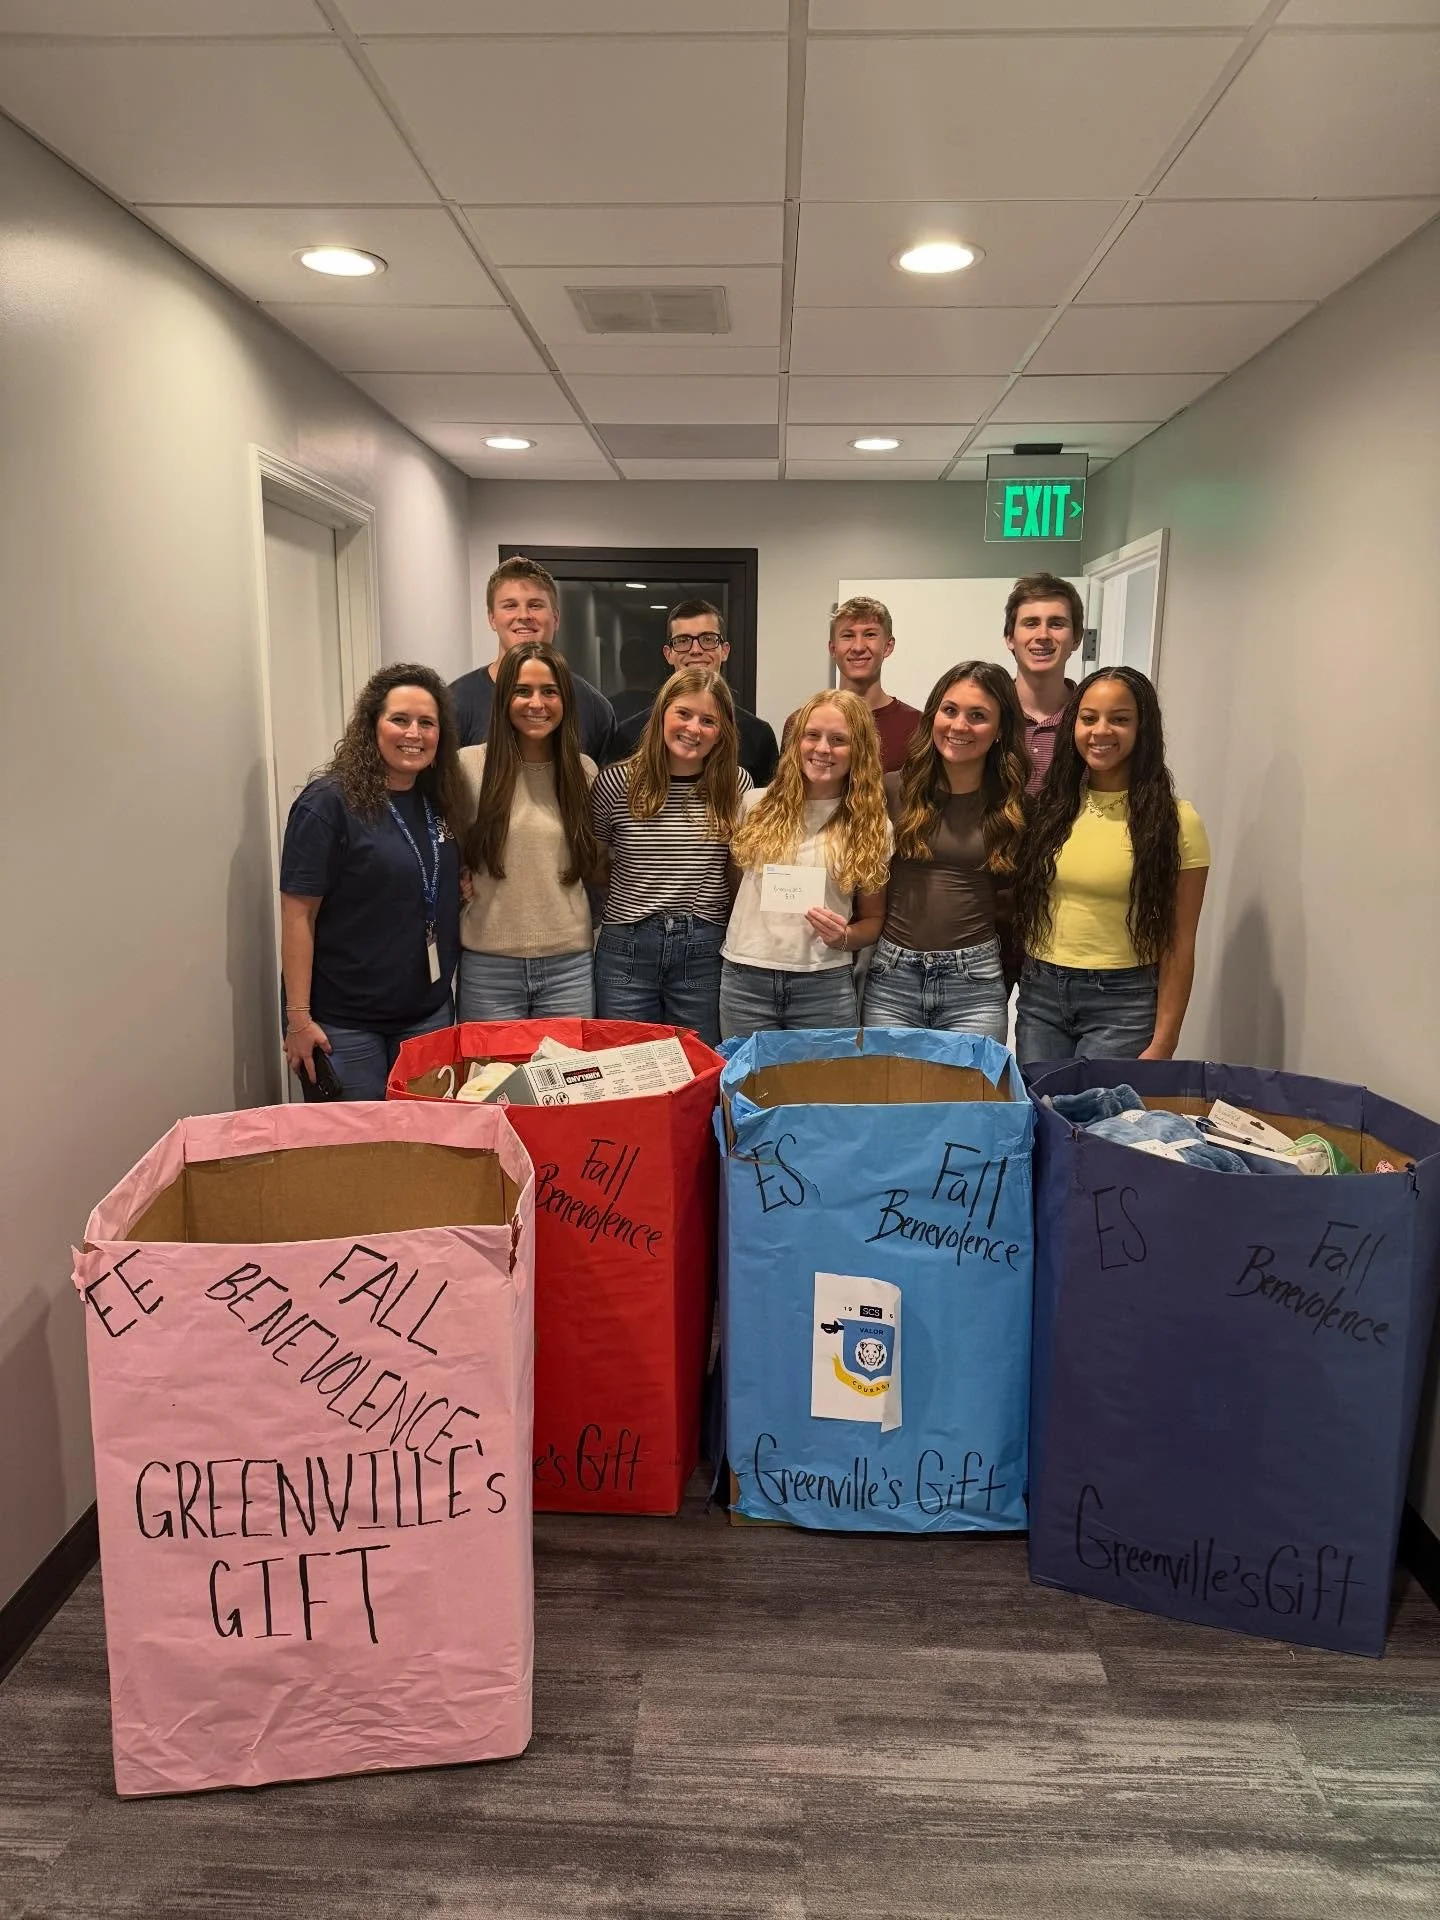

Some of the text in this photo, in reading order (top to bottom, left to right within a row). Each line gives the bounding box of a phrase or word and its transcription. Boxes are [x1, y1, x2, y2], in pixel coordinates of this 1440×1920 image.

[1004, 485, 1070, 537] EXIT
[566, 1071, 601, 1084] KIRKLAND
[535, 1163, 662, 1257] Benevolence
[580, 1138, 640, 1201] Fall
[750, 1133, 806, 1213] ES
[932, 1142, 1008, 1230] Fall
[865, 1189, 1020, 1271] Benevolence
[1092, 1186, 1147, 1271] ES
[1309, 1221, 1388, 1296] Fall
[85, 1249, 163, 1337] EE
[319, 1244, 448, 1355] FALL
[859, 1327, 884, 1336] VALOR
[861, 1306, 881, 1318] SCS
[1227, 1245, 1390, 1345] Benevolence
[205, 1263, 480, 1465] BENEVOLENCE
[576, 1424, 643, 1492] Gift
[754, 1433, 1006, 1515] Greenville's Gift
[209, 1545, 391, 1644] GIFT
[1075, 1484, 1365, 1627] Greenville's Gift
